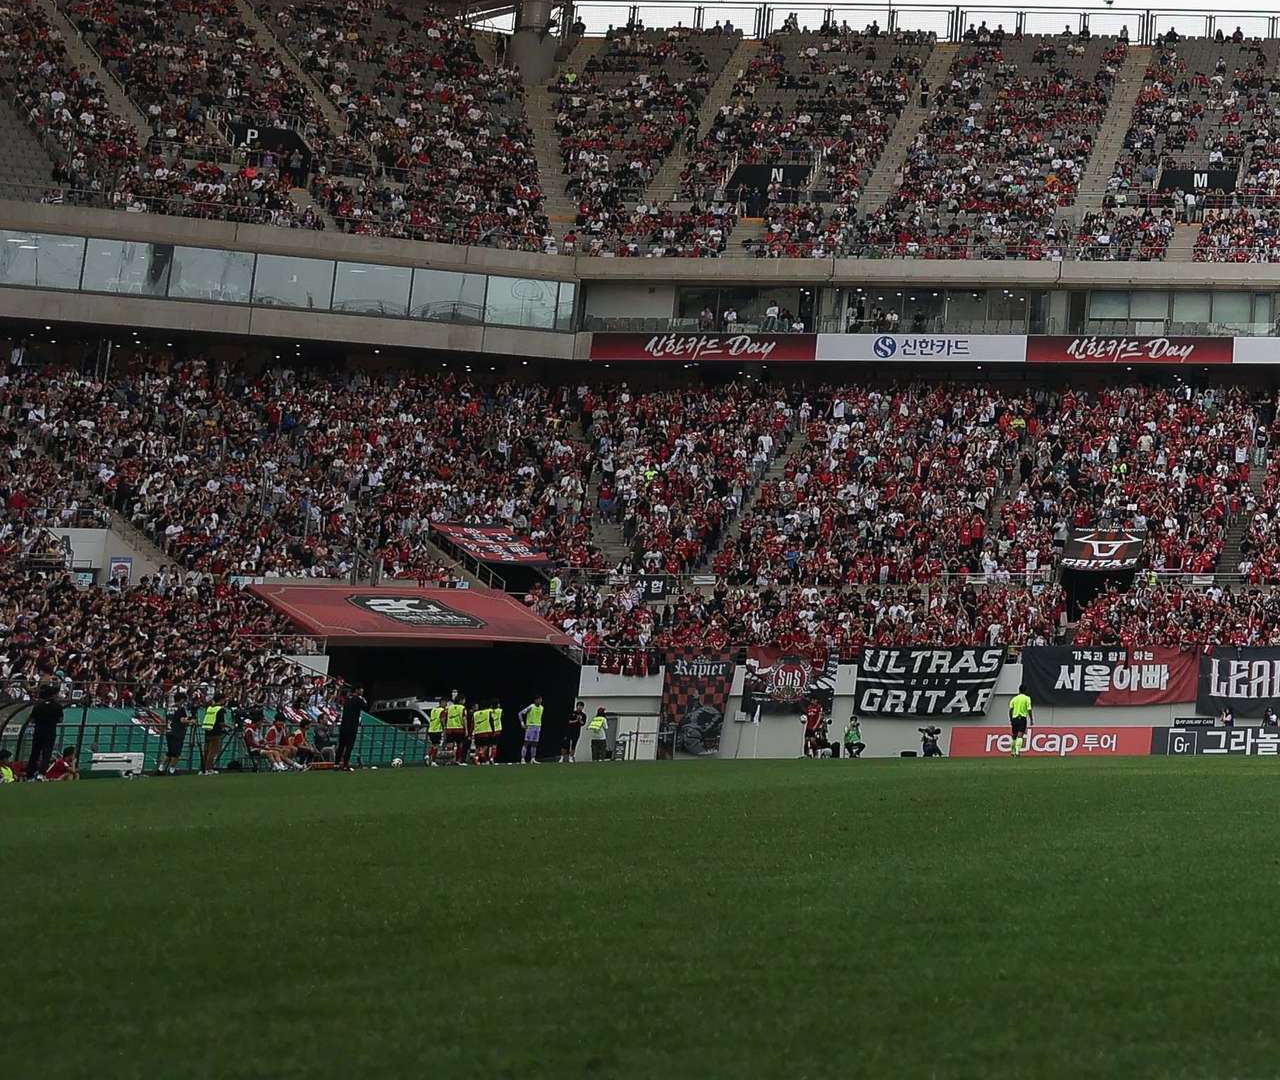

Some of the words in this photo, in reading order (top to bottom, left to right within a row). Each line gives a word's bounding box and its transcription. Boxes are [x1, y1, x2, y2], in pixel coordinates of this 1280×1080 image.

[247, 129, 258, 145] P
[771, 168, 783, 182] N
[1193, 173, 1208, 187] M
[644, 333, 723, 360] 신한카드
[726, 335, 777, 359] Day
[901, 339, 969, 357] 신한카드
[1067, 336, 1142, 361] 신한카드
[1146, 339, 1195, 360] Day
[863, 649, 1003, 674] ULTRAS
[1072, 651, 1103, 662] 가족과
[1133, 651, 1154, 661] 하는
[673, 660, 726, 677] Rapier
[910, 678, 951, 686] 2017
[1054, 664, 1170, 692] 서울아빠
[985, 728, 1078, 757] redcap
[1083, 734, 1118, 752] 투어
[1174, 736, 1190, 753] Gr
